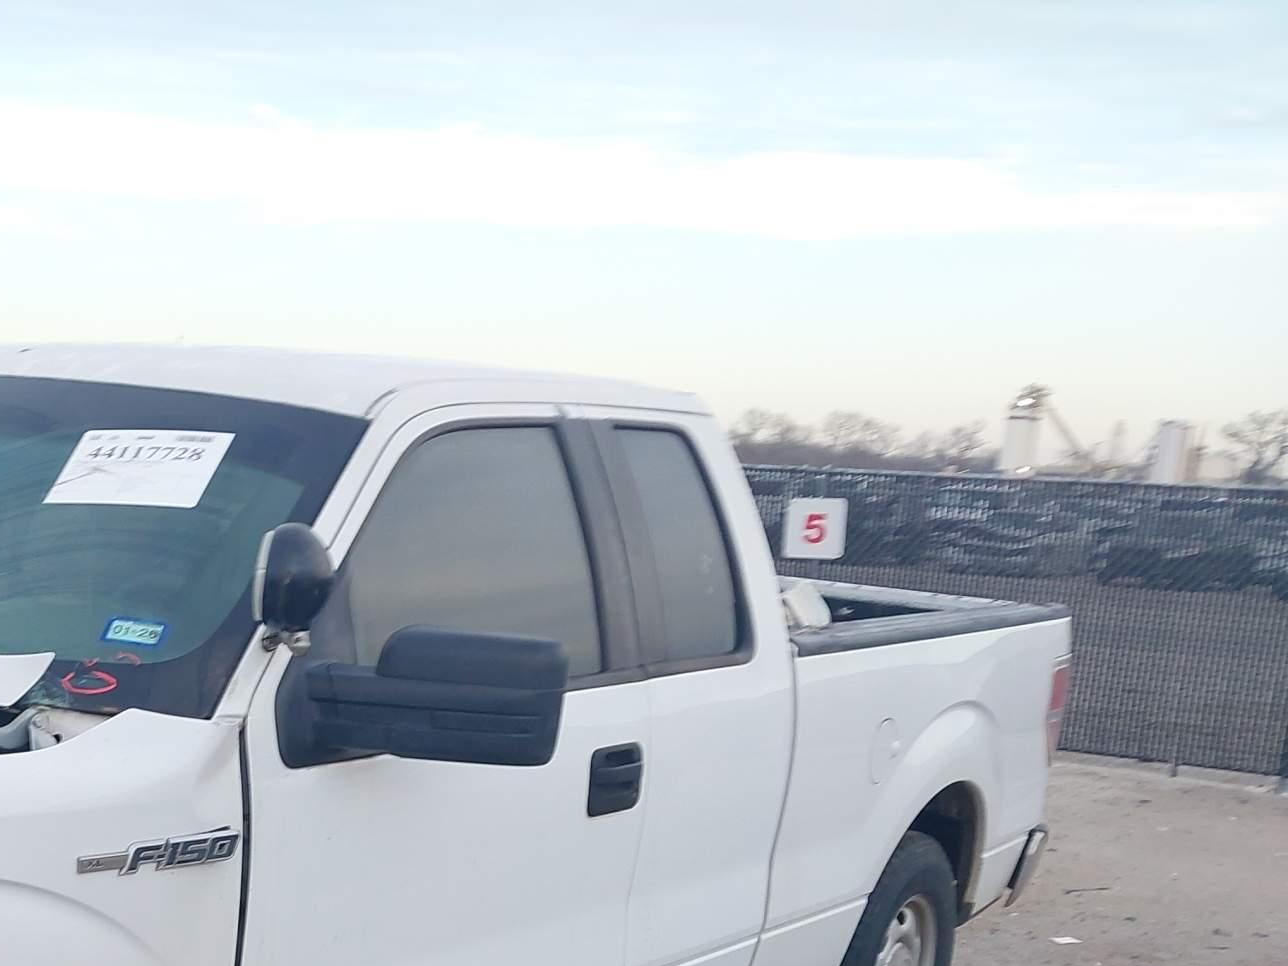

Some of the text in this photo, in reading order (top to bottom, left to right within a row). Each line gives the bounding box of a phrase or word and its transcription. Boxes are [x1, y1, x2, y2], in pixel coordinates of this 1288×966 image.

[88, 445, 206, 462] 44117728
[803, 513, 827, 544] 5
[118, 828, 240, 876] F-150
